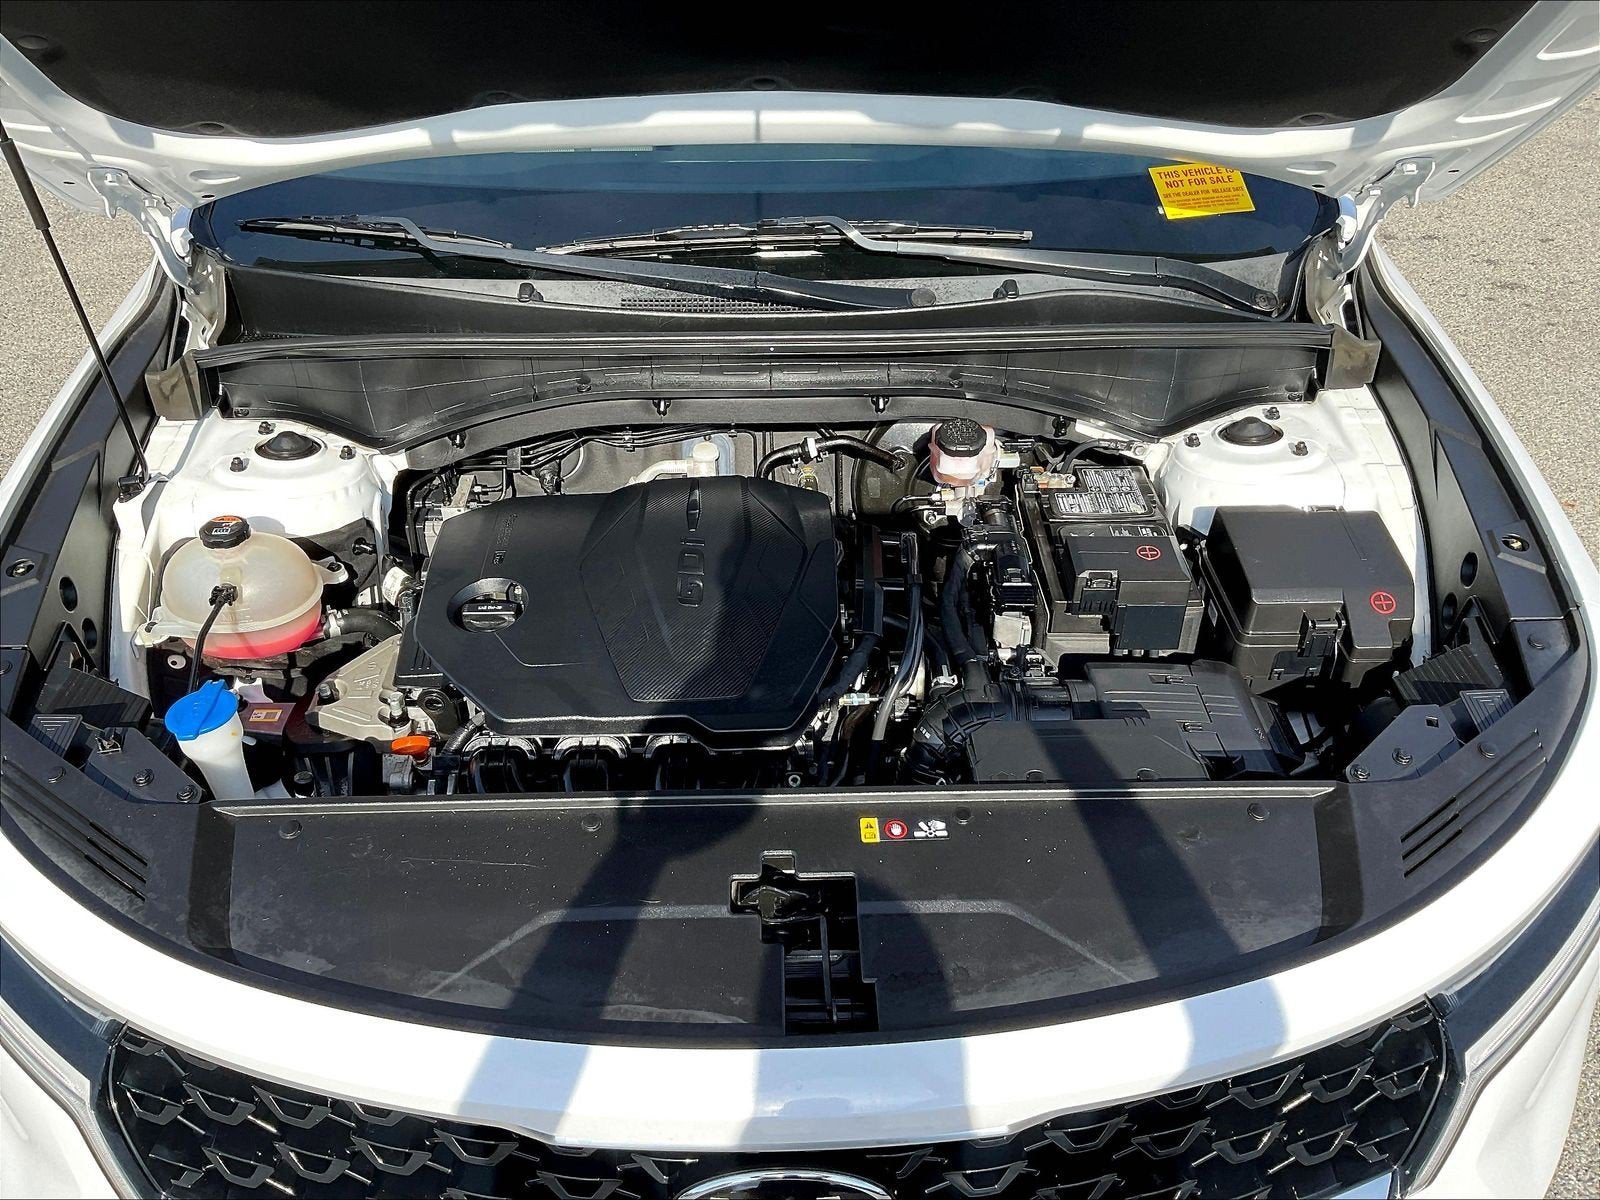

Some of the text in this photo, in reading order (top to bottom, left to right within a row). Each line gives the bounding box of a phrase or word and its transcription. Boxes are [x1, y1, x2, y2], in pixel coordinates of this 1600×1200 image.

[1157, 170, 1180, 180] THIS
[1182, 167, 1223, 178] VEHICLE
[1165, 175, 1234, 189] NOT FOR SALE
